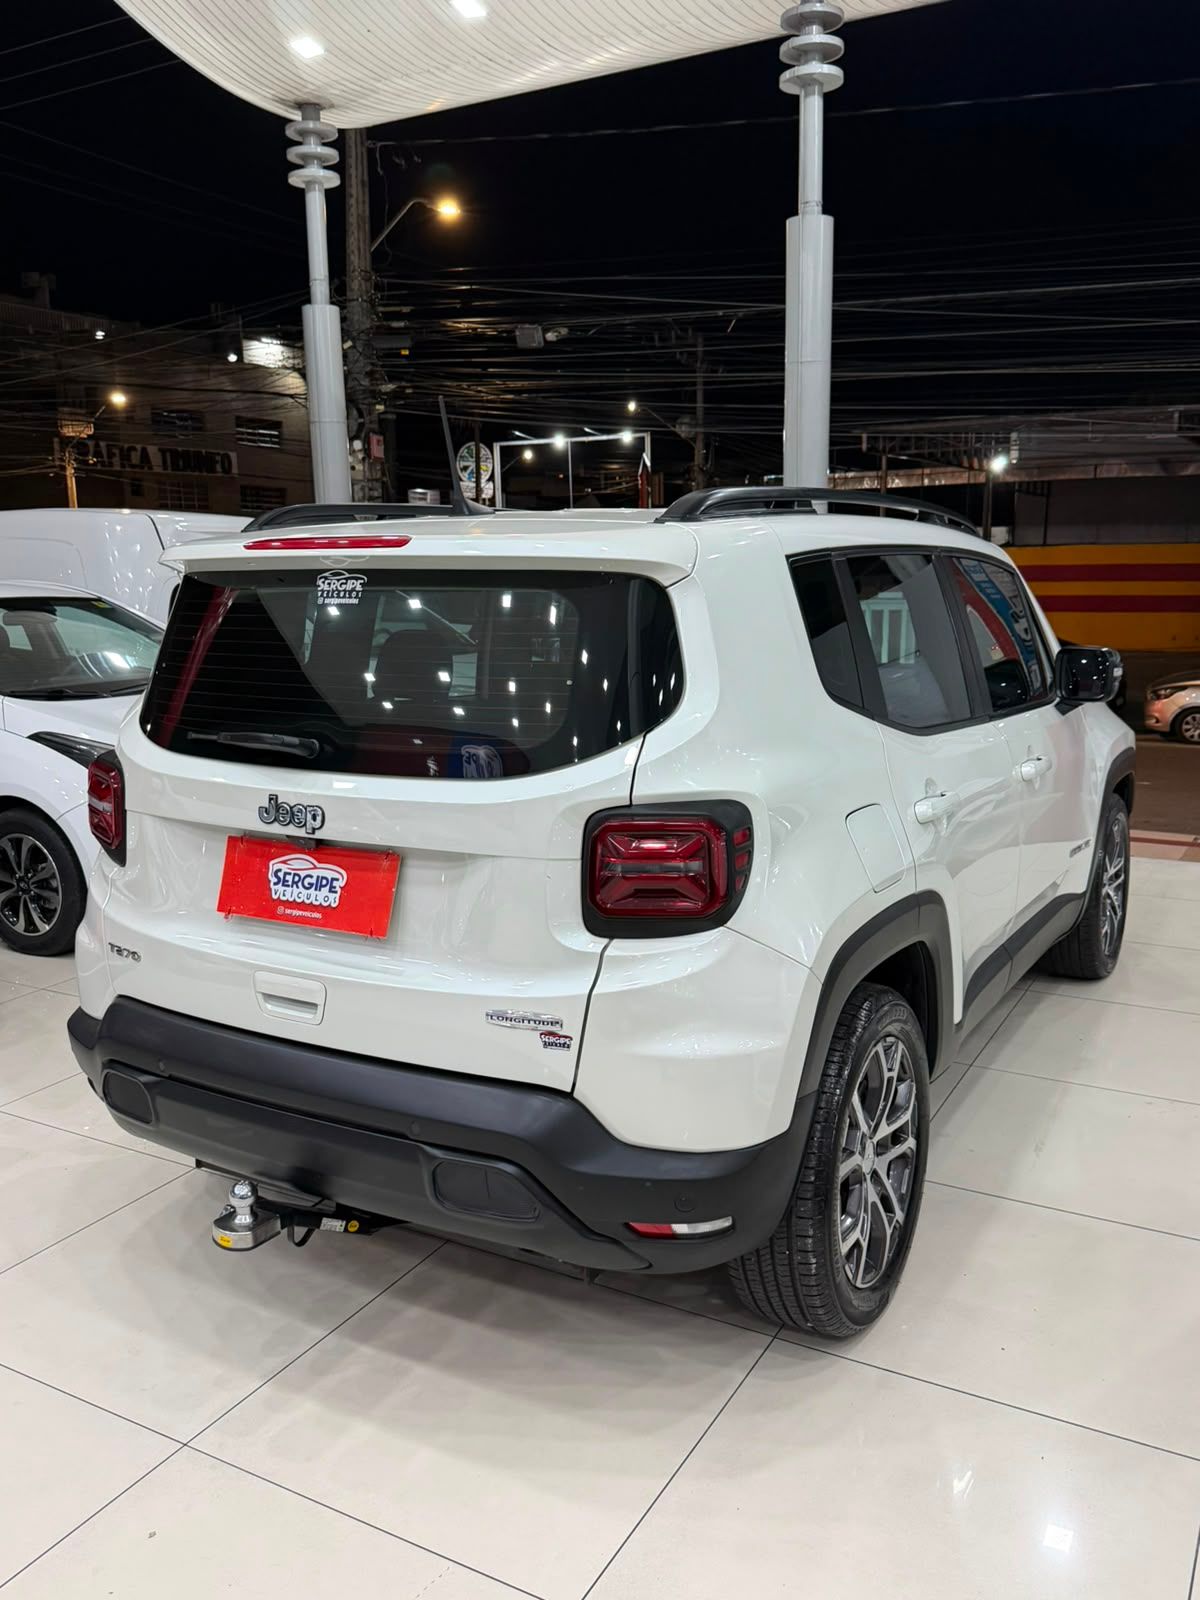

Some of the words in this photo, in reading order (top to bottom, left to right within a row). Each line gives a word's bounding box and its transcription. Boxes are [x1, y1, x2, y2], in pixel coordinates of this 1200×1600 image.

[317, 578, 364, 591] SERGIPE
[258, 793, 325, 835] Jeep
[273, 868, 340, 894] SERGIPE
[108, 941, 142, 963] T270
[489, 1014, 561, 1027] LONGITUDE
